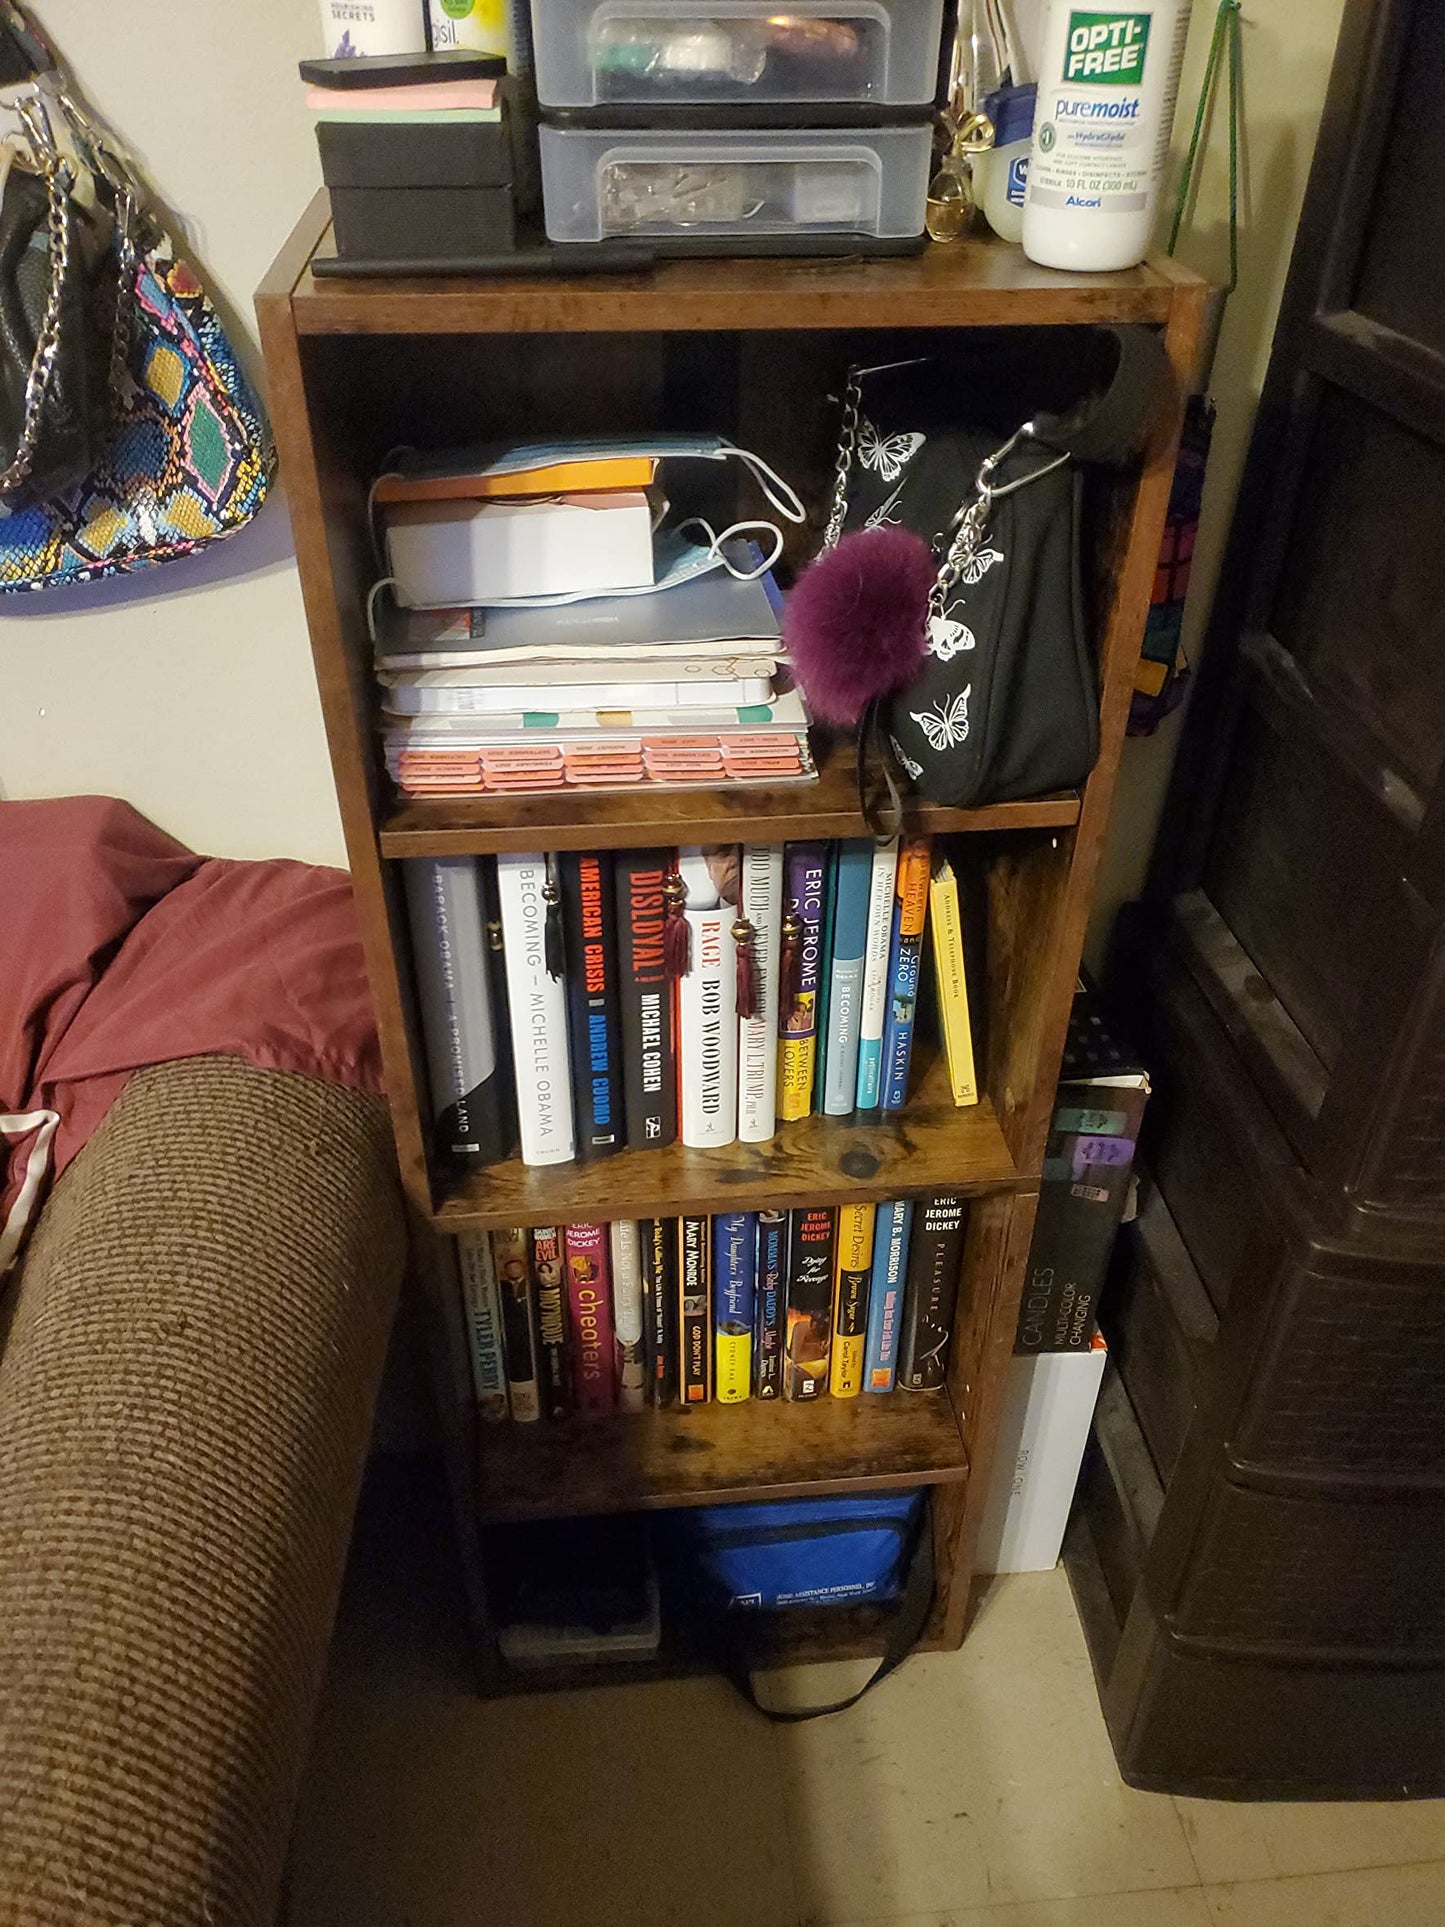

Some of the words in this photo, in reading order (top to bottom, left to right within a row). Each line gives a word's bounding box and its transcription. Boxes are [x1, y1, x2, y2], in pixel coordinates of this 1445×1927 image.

[331, 10, 375, 22] SECRETS
[432, 20, 460, 49] gisil.
[1070, 18, 1141, 53] OPTI-
[1068, 45, 1140, 78] FREE
[1055, 97, 1139, 120] puremoist
[1065, 195, 1102, 208] Alcon
[1077, 180, 1086, 190] FL
[1089, 180, 1101, 190] OZ
[435, 874, 449, 934] BARACK
[579, 857, 604, 939] AMERICAN
[750, 876, 770, 911] MUCH
[804, 869, 822, 910] ERIC
[881, 872, 893, 924] MICHELLE
[903, 883, 919, 933] HEAVEN
[519, 869, 542, 967] BECOMING
[701, 920, 721, 968] RAGE
[801, 917, 819, 986] JEROME
[878, 924, 889, 960] OBAMA
[440, 940, 454, 989] OBAMA
[583, 943, 605, 994] CRISIS
[898, 948, 911, 982] ZERO
[908, 954, 921, 997] Ground
[702, 979, 721, 1016] BOB
[838, 986, 851, 1044] BECOMING
[529, 993, 550, 1073] MICHELLE
[641, 993, 660, 1049] MICHAEL
[747, 1020, 766, 1053] MARY
[588, 1015, 609, 1075] ANDREW
[894, 1032, 908, 1080] HASKIN
[642, 1049, 662, 1093] COHEN
[702, 1020, 722, 1115] WOODWARD
[784, 1045, 795, 1088] LOVERS
[797, 1039, 809, 1091] BETWEEN
[456, 1100, 470, 1133] LAND
[536, 1080, 553, 1137] OBAMA
[590, 1077, 611, 1126] CUOMO
[725, 1215, 745, 1233] My
[801, 1222, 831, 1232] JEROME
[806, 1212, 827, 1221] ERIC
[852, 1205, 867, 1234] Secret
[925, 1208, 962, 1218] JEROME
[925, 1220, 960, 1231] DICKEY
[536, 1239, 556, 1250] ARE
[566, 1227, 600, 1239] JEROME
[567, 1237, 601, 1248] DICKEY
[686, 1221, 700, 1247] MARY
[801, 1232, 831, 1242] DICKEY
[892, 1227, 902, 1237] B.
[535, 1249, 557, 1261] EVIL
[686, 1250, 700, 1287] MONROE
[724, 1237, 745, 1276] Daughter's
[850, 1235, 865, 1269] Desires
[887, 1238, 902, 1284] MORRISON
[929, 1243, 946, 1310] PLEASURE
[723, 1279, 744, 1315] Boyfriend
[766, 1292, 777, 1329] DADDY'S
[1022, 1267, 1055, 1346] CANDLES
[1054, 1282, 1077, 1345] MULTI-COLOR
[475, 1308, 494, 1349] TYLER
[539, 1287, 564, 1345] MO'NIQUE
[692, 1325, 702, 1339] GOD
[1069, 1295, 1092, 1346] CHANGING
[578, 1289, 604, 1381] cheaters
[692, 1340, 701, 1359] DON'T
[479, 1351, 500, 1390] PERRY
[692, 1360, 701, 1376] PLAY
